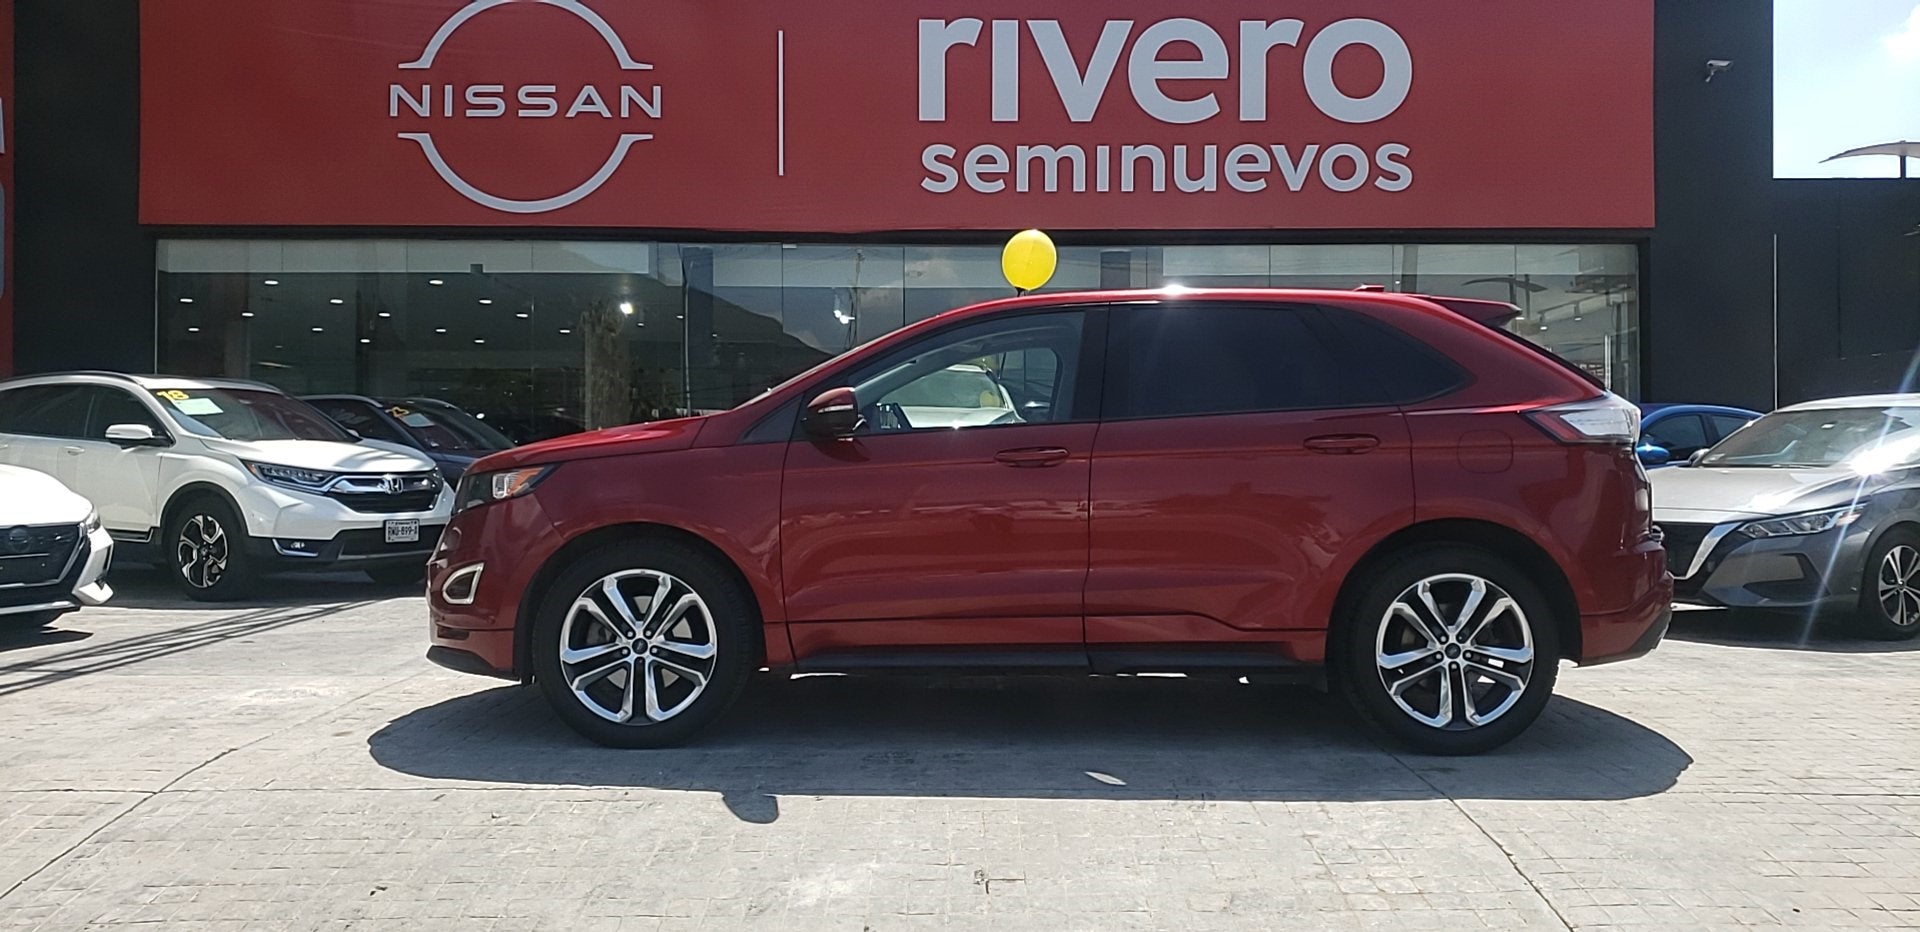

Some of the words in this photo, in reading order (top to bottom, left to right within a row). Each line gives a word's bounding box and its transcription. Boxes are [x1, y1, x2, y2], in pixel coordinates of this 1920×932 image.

[918, 17, 1413, 124] rivero
[389, 84, 662, 118] NISSAN
[920, 143, 1414, 193] seminuevos
